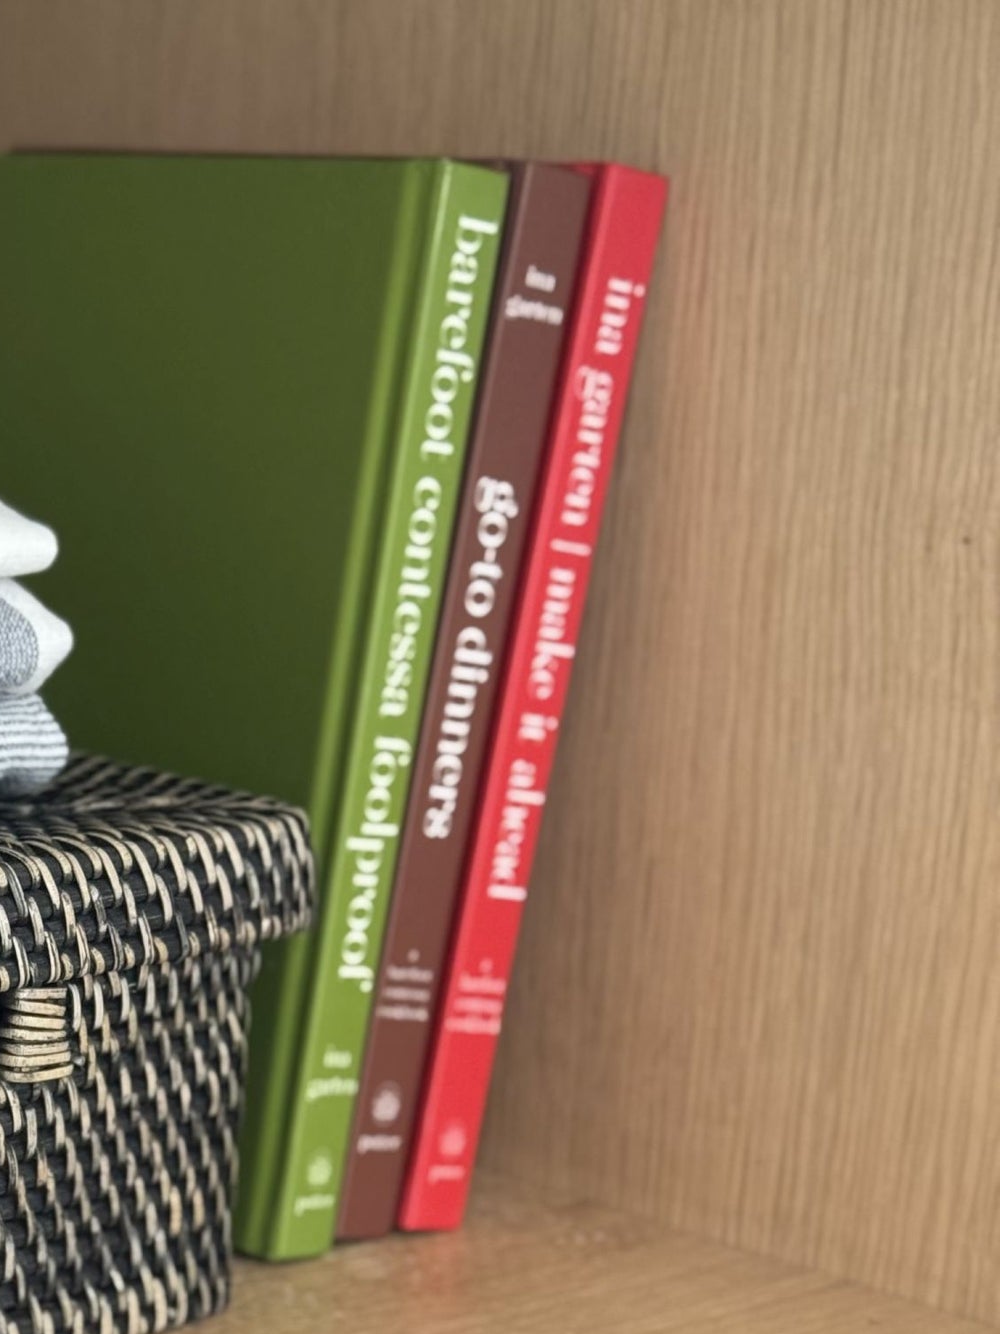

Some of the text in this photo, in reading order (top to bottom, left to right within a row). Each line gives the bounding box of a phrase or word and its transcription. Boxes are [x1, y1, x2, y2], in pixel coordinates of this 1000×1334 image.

[420, 213, 499, 461] barefoot
[594, 276, 646, 355] ina
[560, 365, 614, 526] garten
[379, 476, 442, 717] contessa
[423, 476, 519, 839] go-to dinners
[529, 567, 576, 700] make
[518, 712, 559, 742] it
[338, 735, 412, 993] foolproof
[487, 758, 546, 902] ahead
